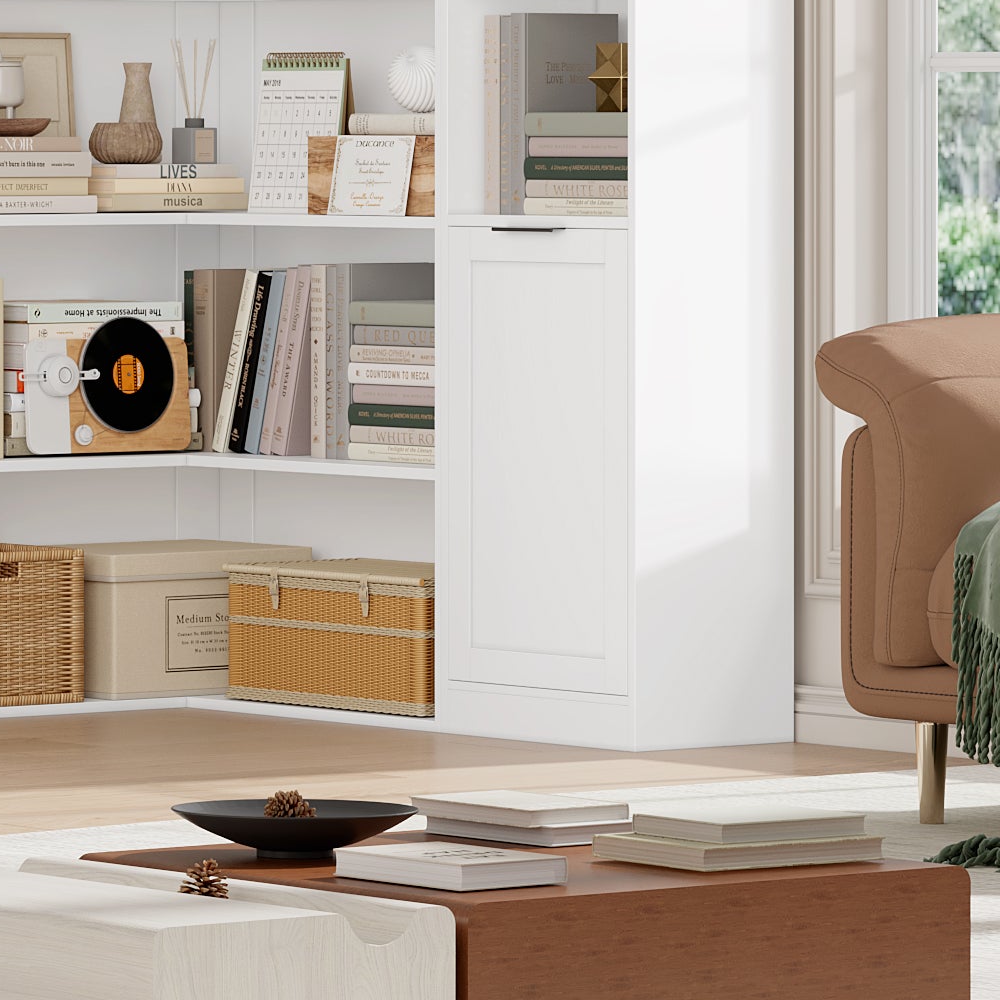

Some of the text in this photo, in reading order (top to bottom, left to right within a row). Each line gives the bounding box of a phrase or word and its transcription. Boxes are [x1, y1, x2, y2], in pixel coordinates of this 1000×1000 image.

[263, 79, 281, 87] MAY 2018
[160, 164, 197, 179] LIVES
[16, 183, 48, 191] IMPERFECT
[553, 185, 595, 197] WHITE
[5, 201, 53, 209] BAXTER-WRIGHT
[163, 195, 203, 207] musica
[64, 309, 85, 317] Home
[95, 309, 147, 318] Impressionists
[149, 309, 162, 317] The
[281, 281, 305, 398] DANIELLE STEEL THE AWARD
[223, 329, 243, 391] WINTER
[365, 369, 429, 380] COUNTDOWN TO MECCA
[326, 368, 335, 436] SWORD
[376, 432, 415, 445] WHITE
[176, 614, 212, 625] Medium
